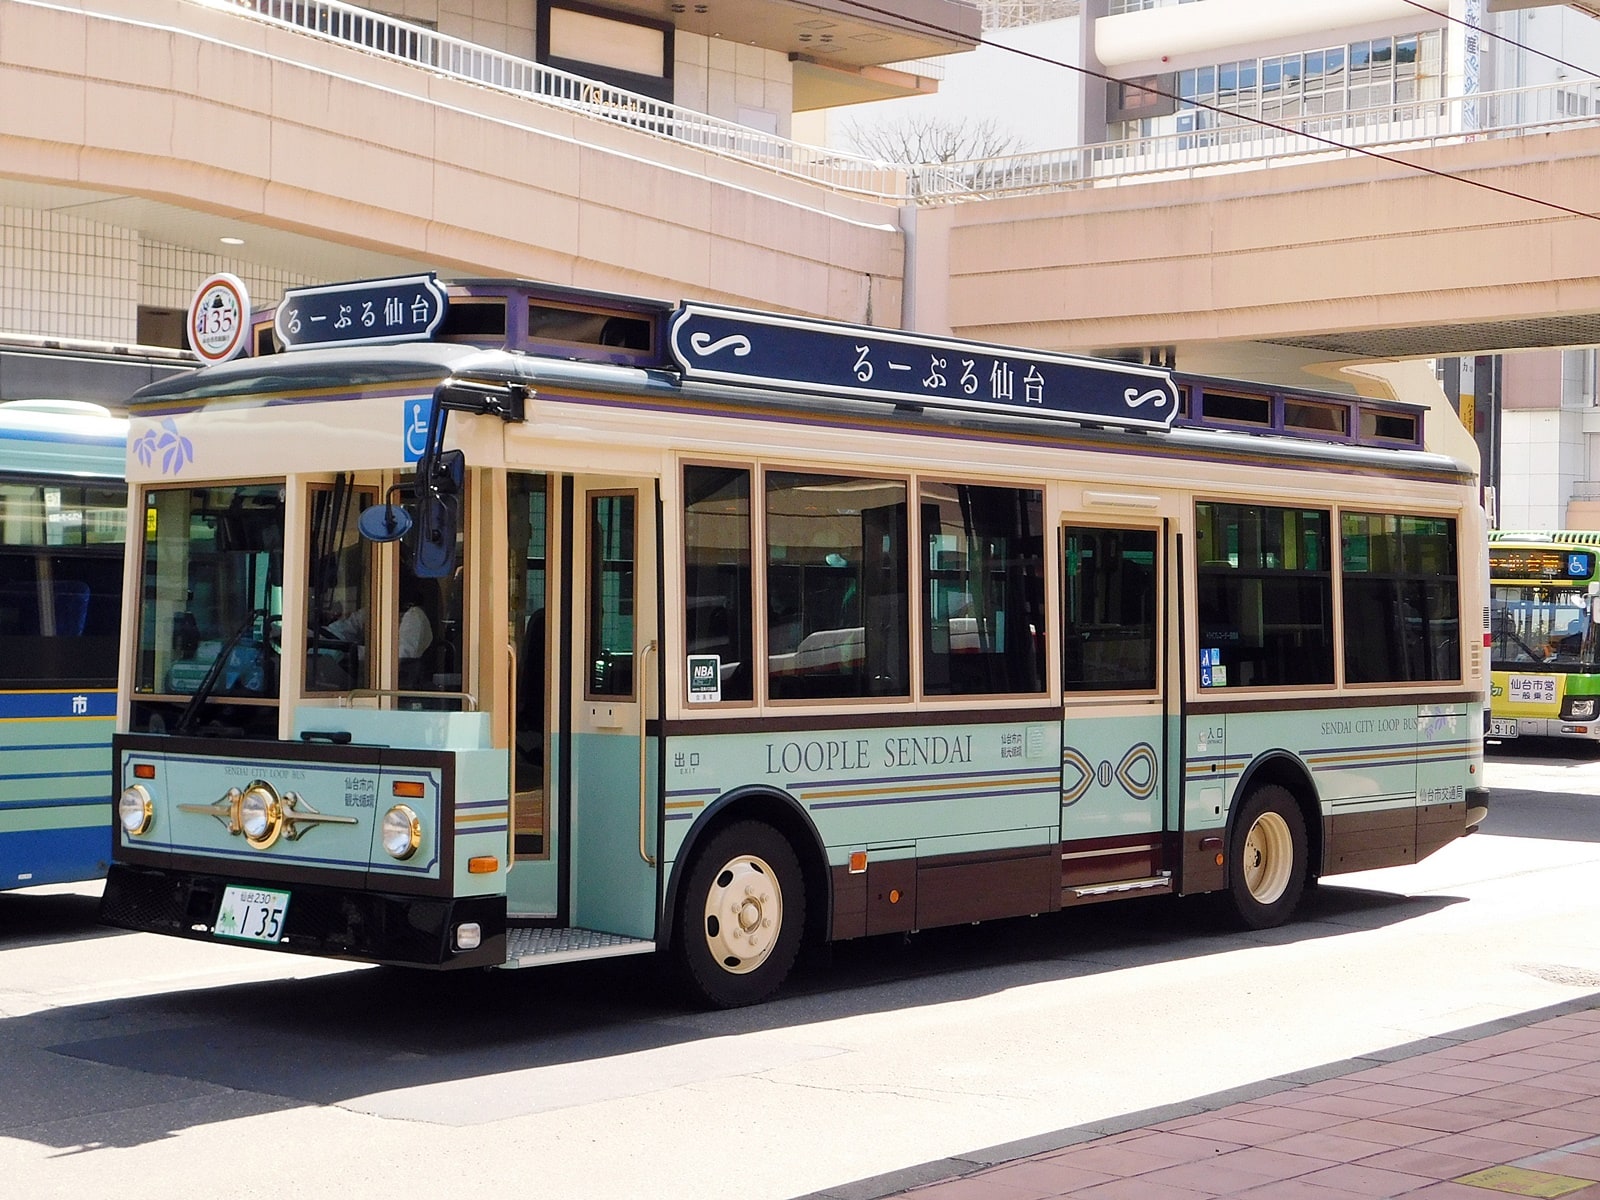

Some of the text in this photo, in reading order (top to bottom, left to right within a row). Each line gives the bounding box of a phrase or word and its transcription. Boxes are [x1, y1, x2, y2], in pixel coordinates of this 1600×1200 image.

[200, 309, 232, 334] 135
[288, 294, 429, 334] るーぷる仙台
[853, 344, 1045, 404] るーぷる仙台
[694, 666, 714, 678] NBA
[1510, 678, 1554, 691] 仙台市営
[1511, 691, 1554, 701] 一般乗合
[72, 695, 88, 714] 市
[1207, 727, 1223, 739] 入口
[1321, 717, 1418, 736] SENDAI CITY LOOP BUS
[674, 751, 700, 767] 出口
[766, 735, 973, 774] LOOPLE SENDAI
[224, 766, 306, 780] SENDAI CITY LOOP BUS
[680, 767, 696, 775] EXIT
[344, 776, 374, 792] 仙台市内
[1420, 785, 1464, 802] 仙台市交通局
